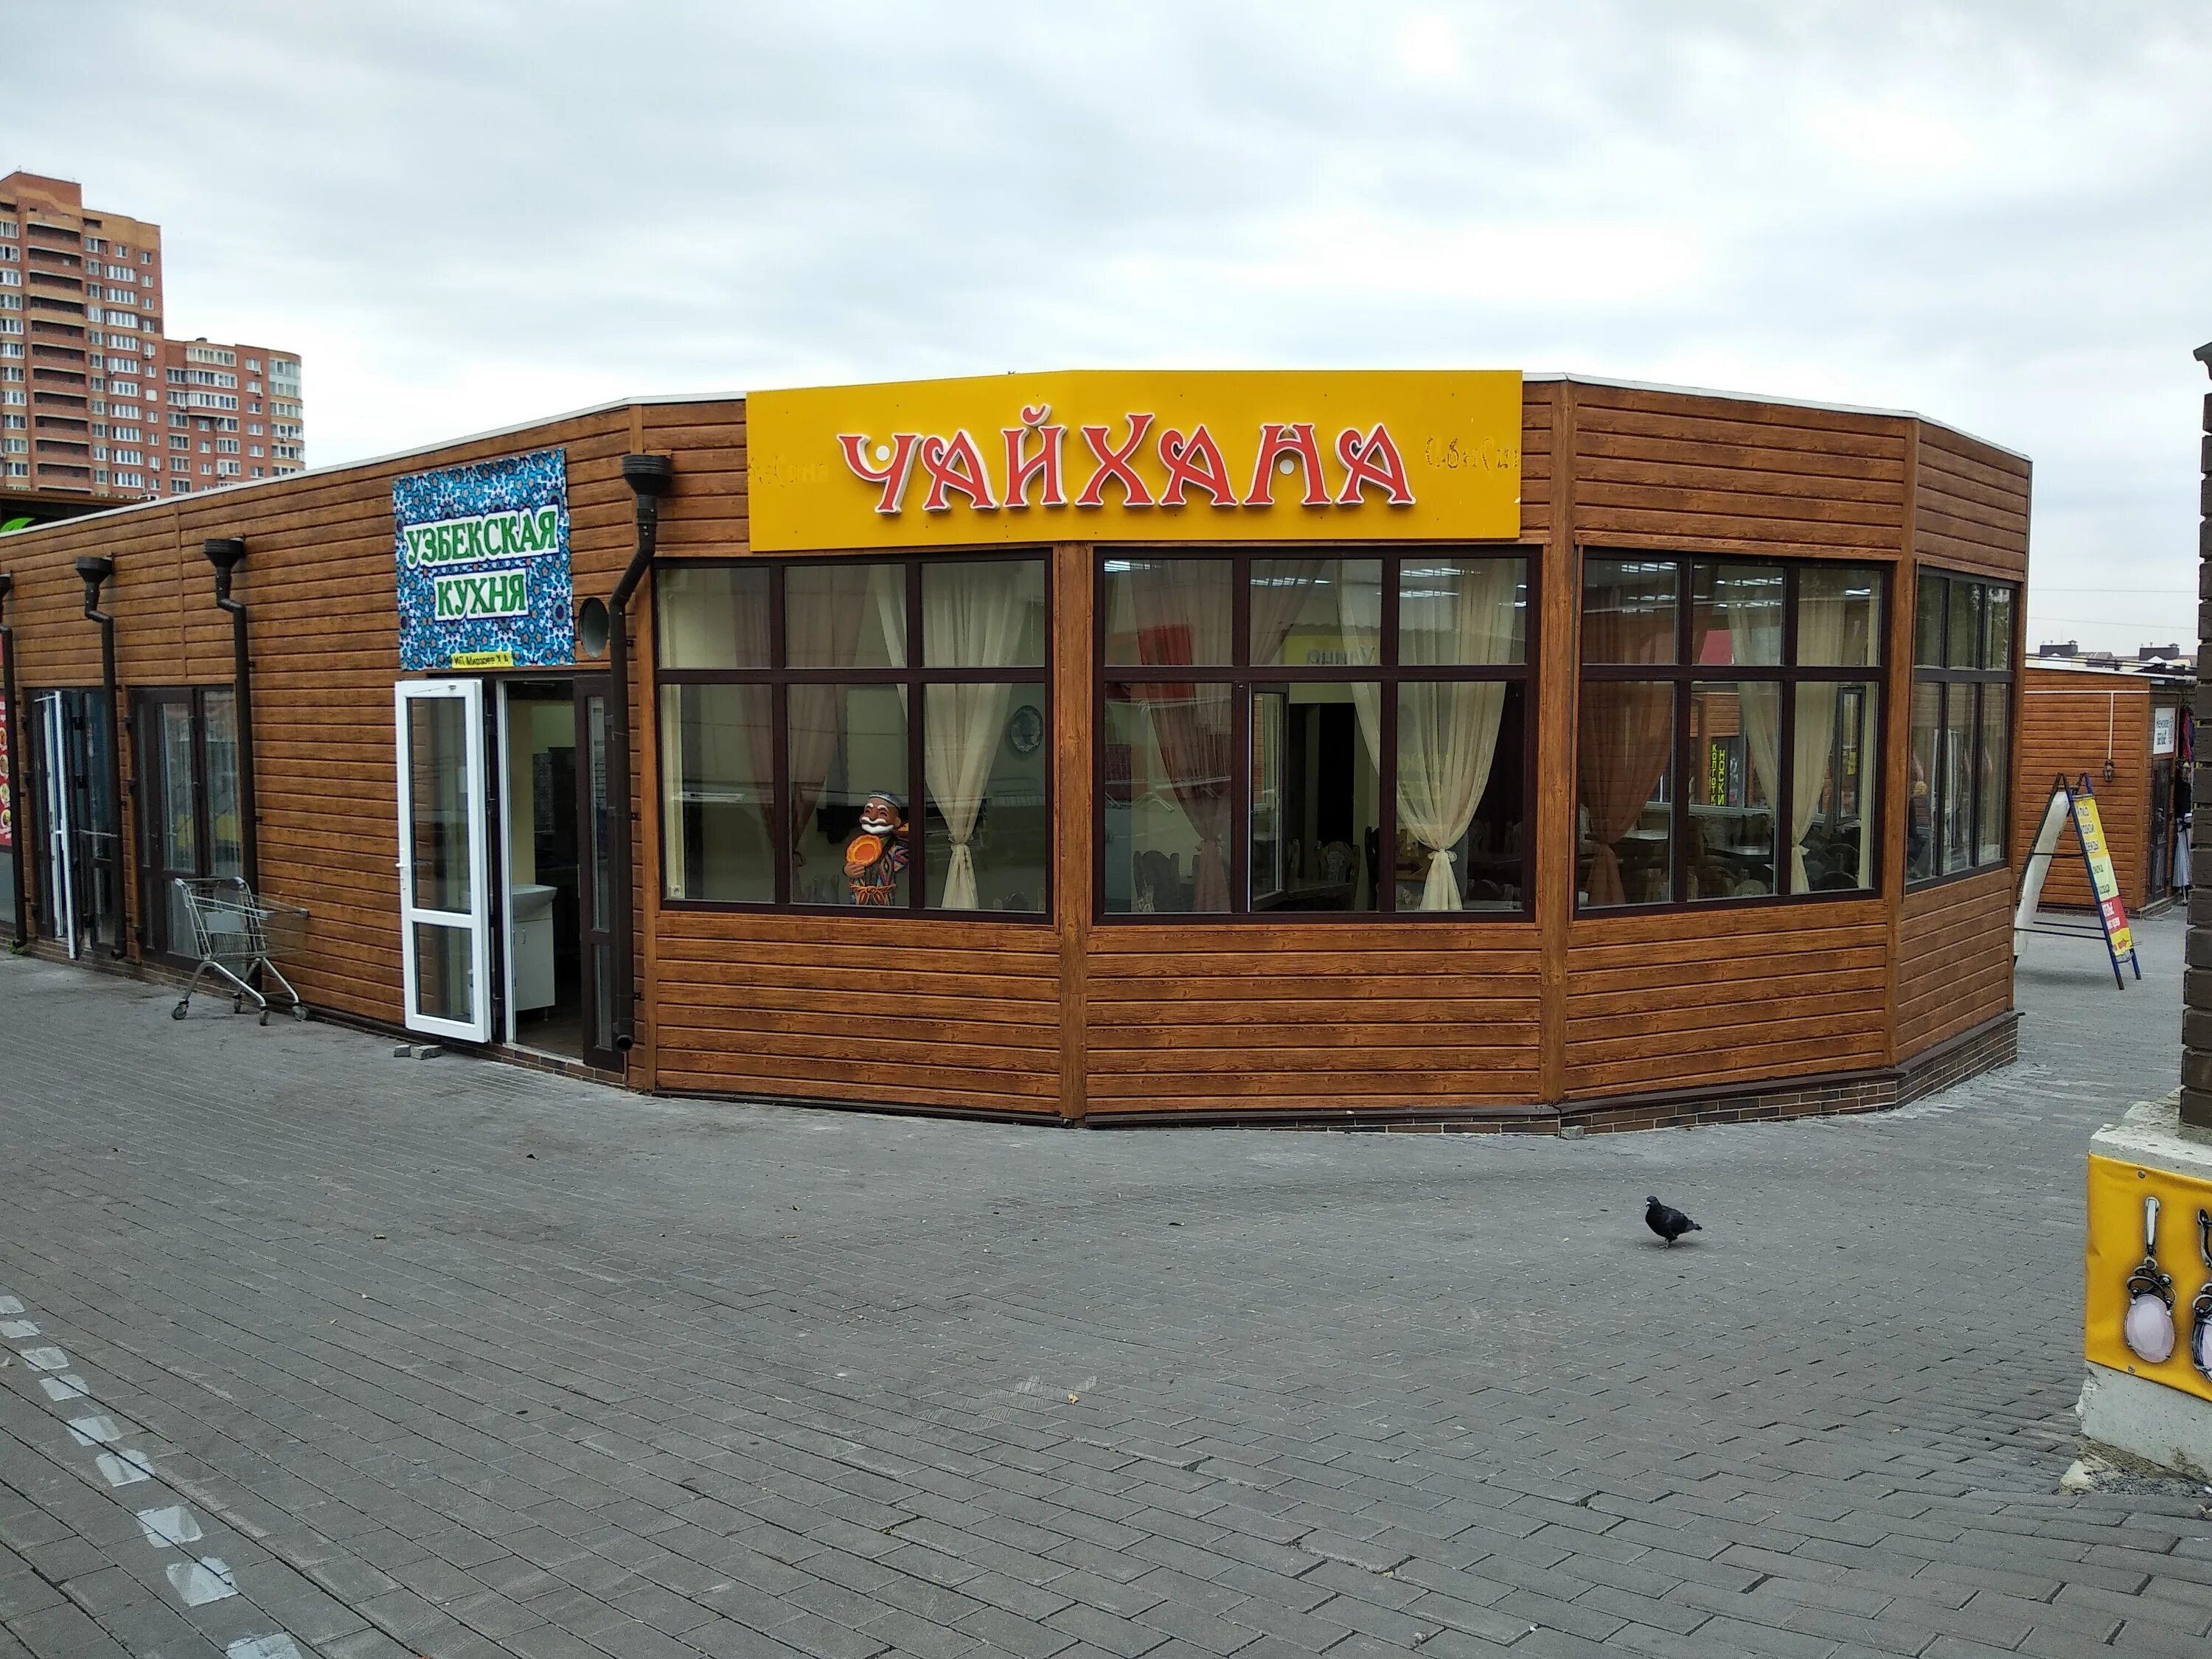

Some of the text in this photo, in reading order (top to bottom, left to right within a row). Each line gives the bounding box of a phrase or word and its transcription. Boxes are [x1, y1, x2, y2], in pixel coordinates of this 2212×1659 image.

[836, 403, 1416, 513] ЧАЙХАНА
[403, 509, 558, 566] УЗБЕКСКАЯ
[436, 573, 526, 617] КУХНЯ
[1717, 749, 1725, 806] НОСКИ
